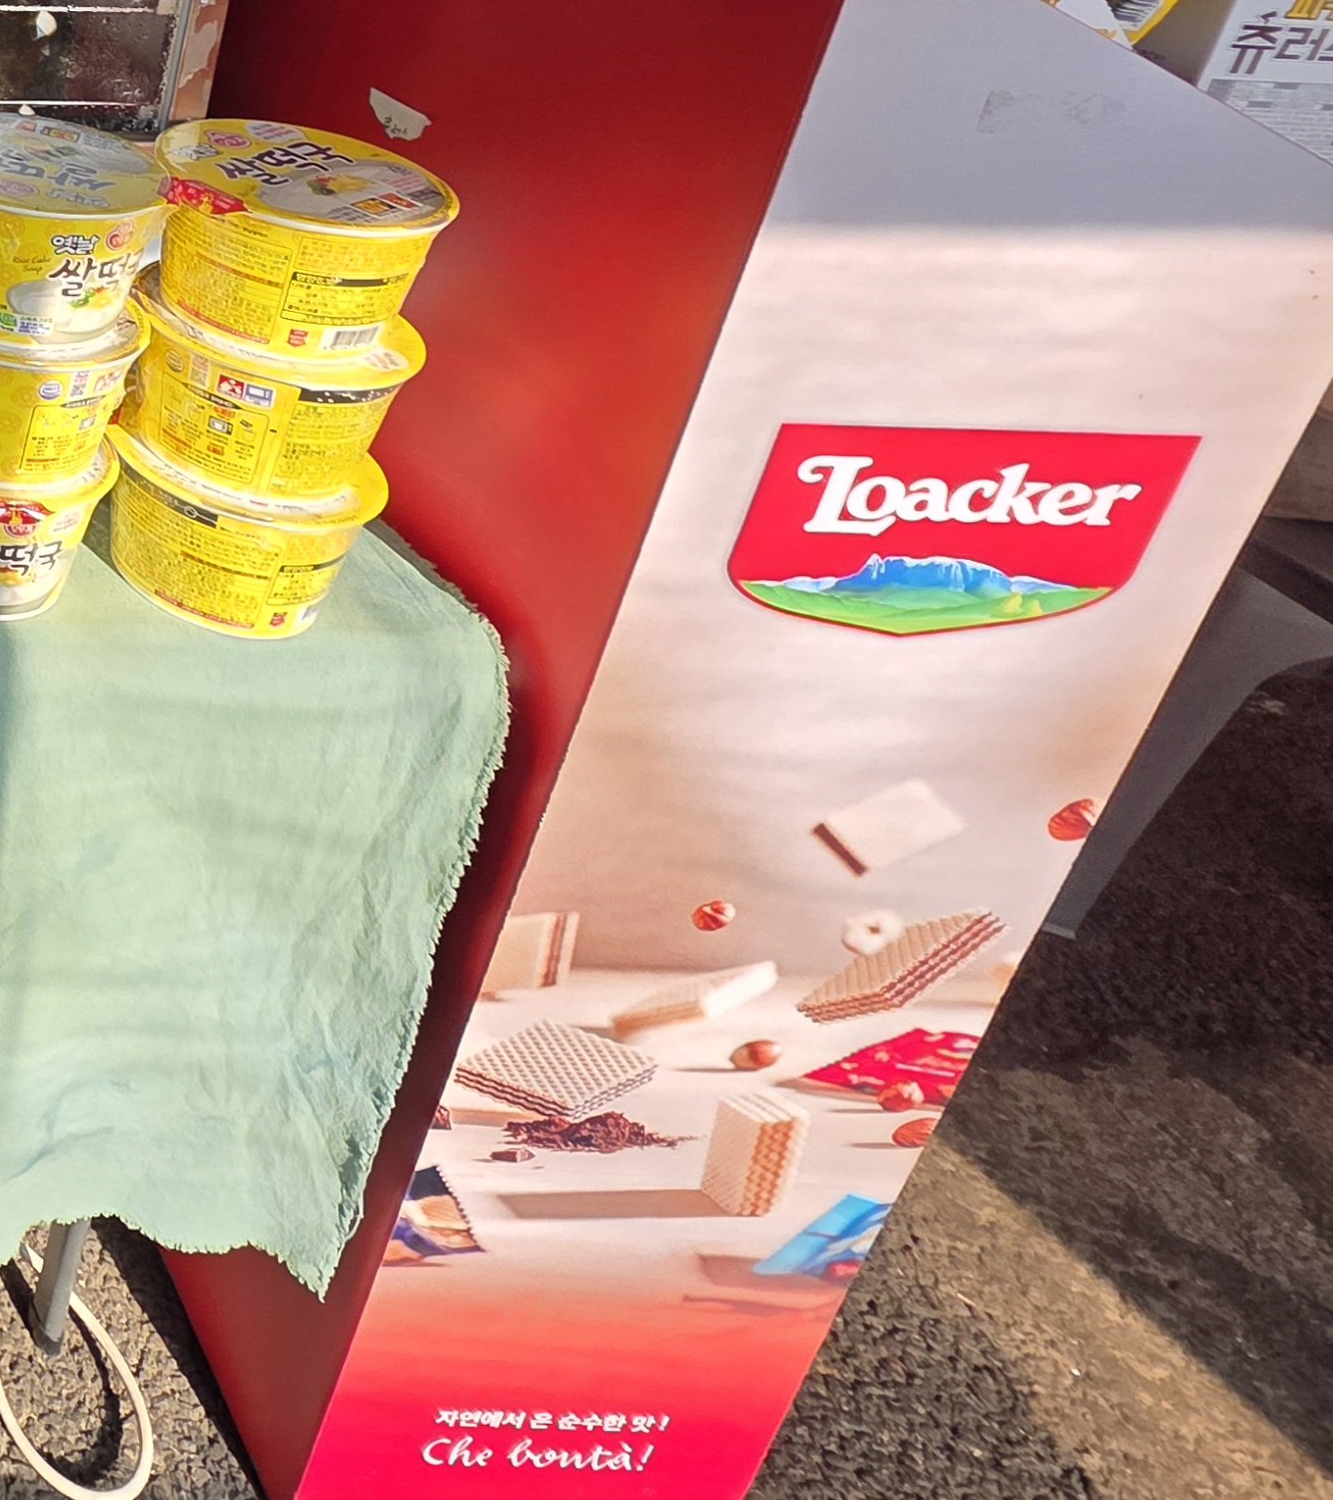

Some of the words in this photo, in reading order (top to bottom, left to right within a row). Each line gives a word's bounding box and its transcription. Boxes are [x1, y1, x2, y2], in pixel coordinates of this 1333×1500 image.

[50, 233, 101, 256] 옛날
[795, 453, 1143, 538] Loacker
[434, 1407, 526, 1430] 자연에서
[529, 1409, 554, 1431] 온
[557, 1411, 628, 1433] 순수한
[421, 1434, 495, 1469] Che
[506, 1436, 656, 1473] bontà!
